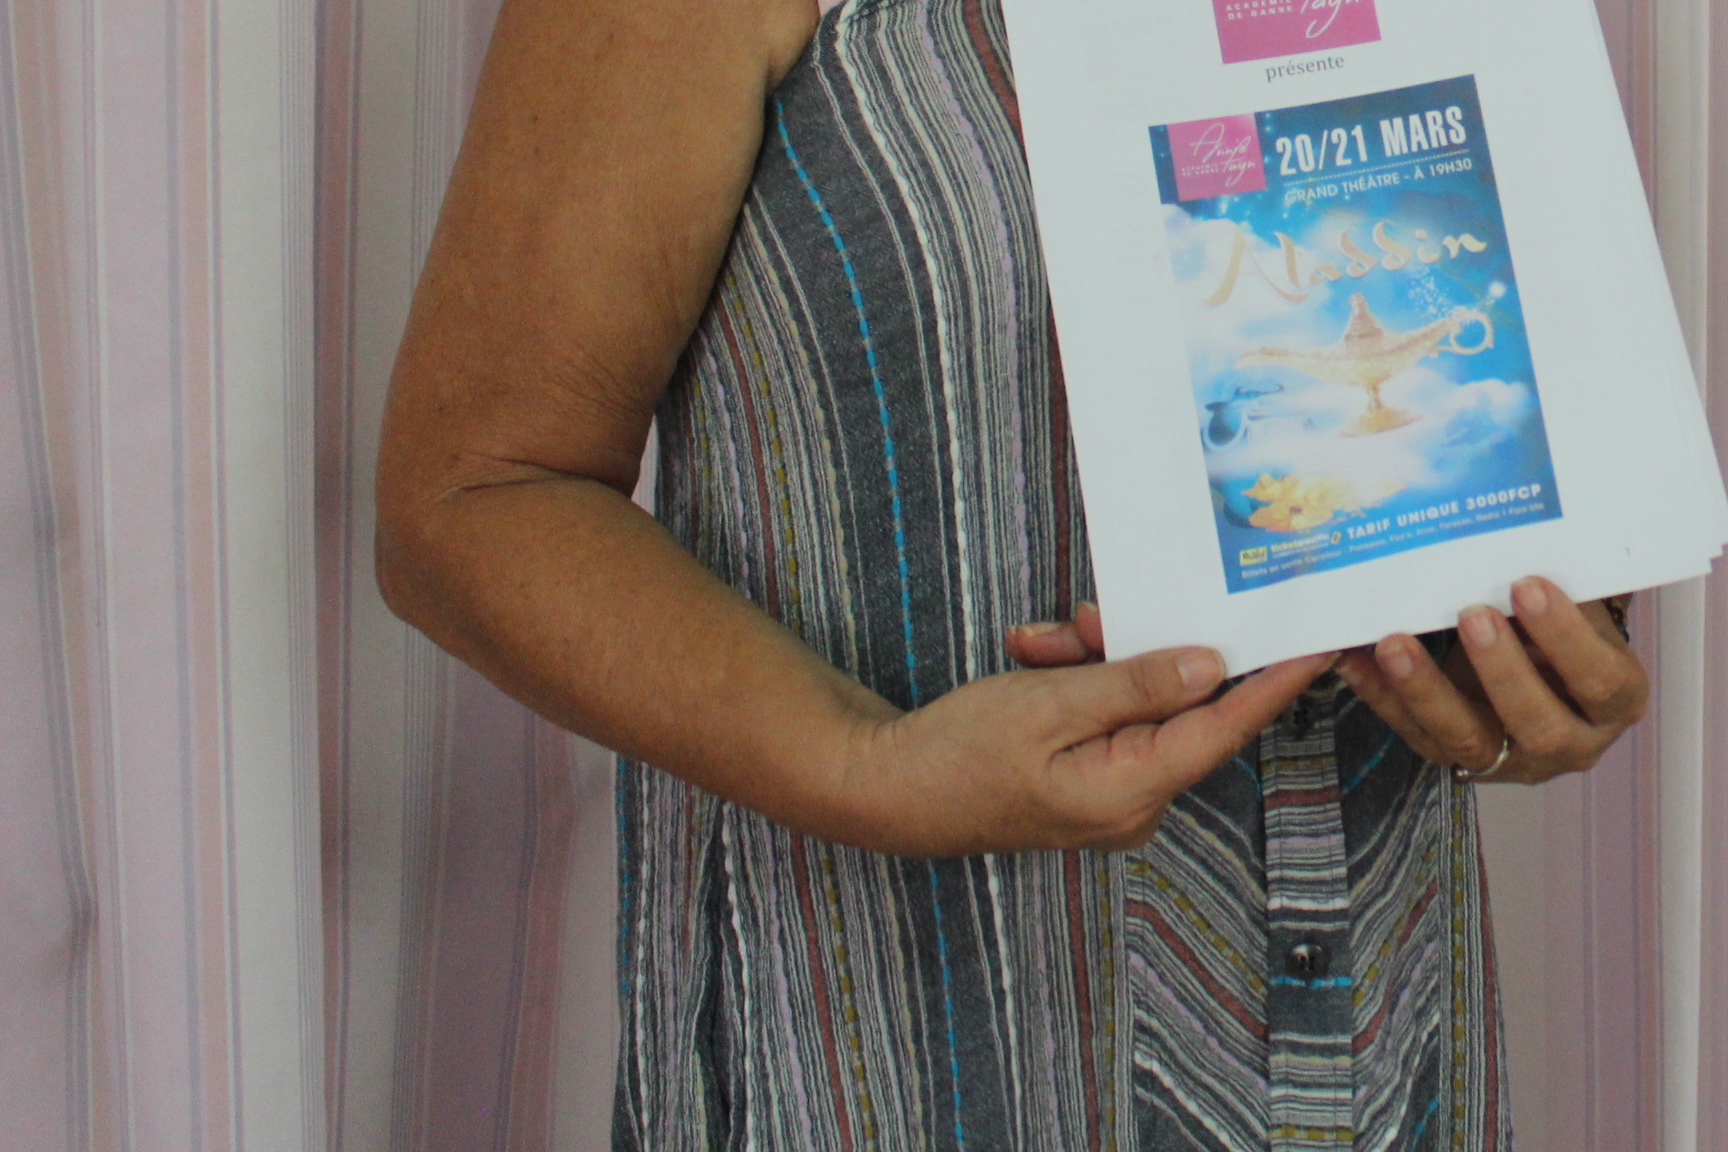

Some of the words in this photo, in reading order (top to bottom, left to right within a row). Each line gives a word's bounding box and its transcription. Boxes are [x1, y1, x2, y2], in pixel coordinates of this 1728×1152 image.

[1228, 11, 1243, 21] DE
[1265, 56, 1345, 83] présente
[1275, 124, 1368, 176] 20/21
[1379, 105, 1467, 157] MARS
[1284, 183, 1338, 204] GRAND
[1429, 157, 1473, 177] 19H30
[1346, 517, 1391, 540] TARIF
[1397, 501, 1459, 527] UNIQUE
[1465, 483, 1542, 512] 3000FCP
